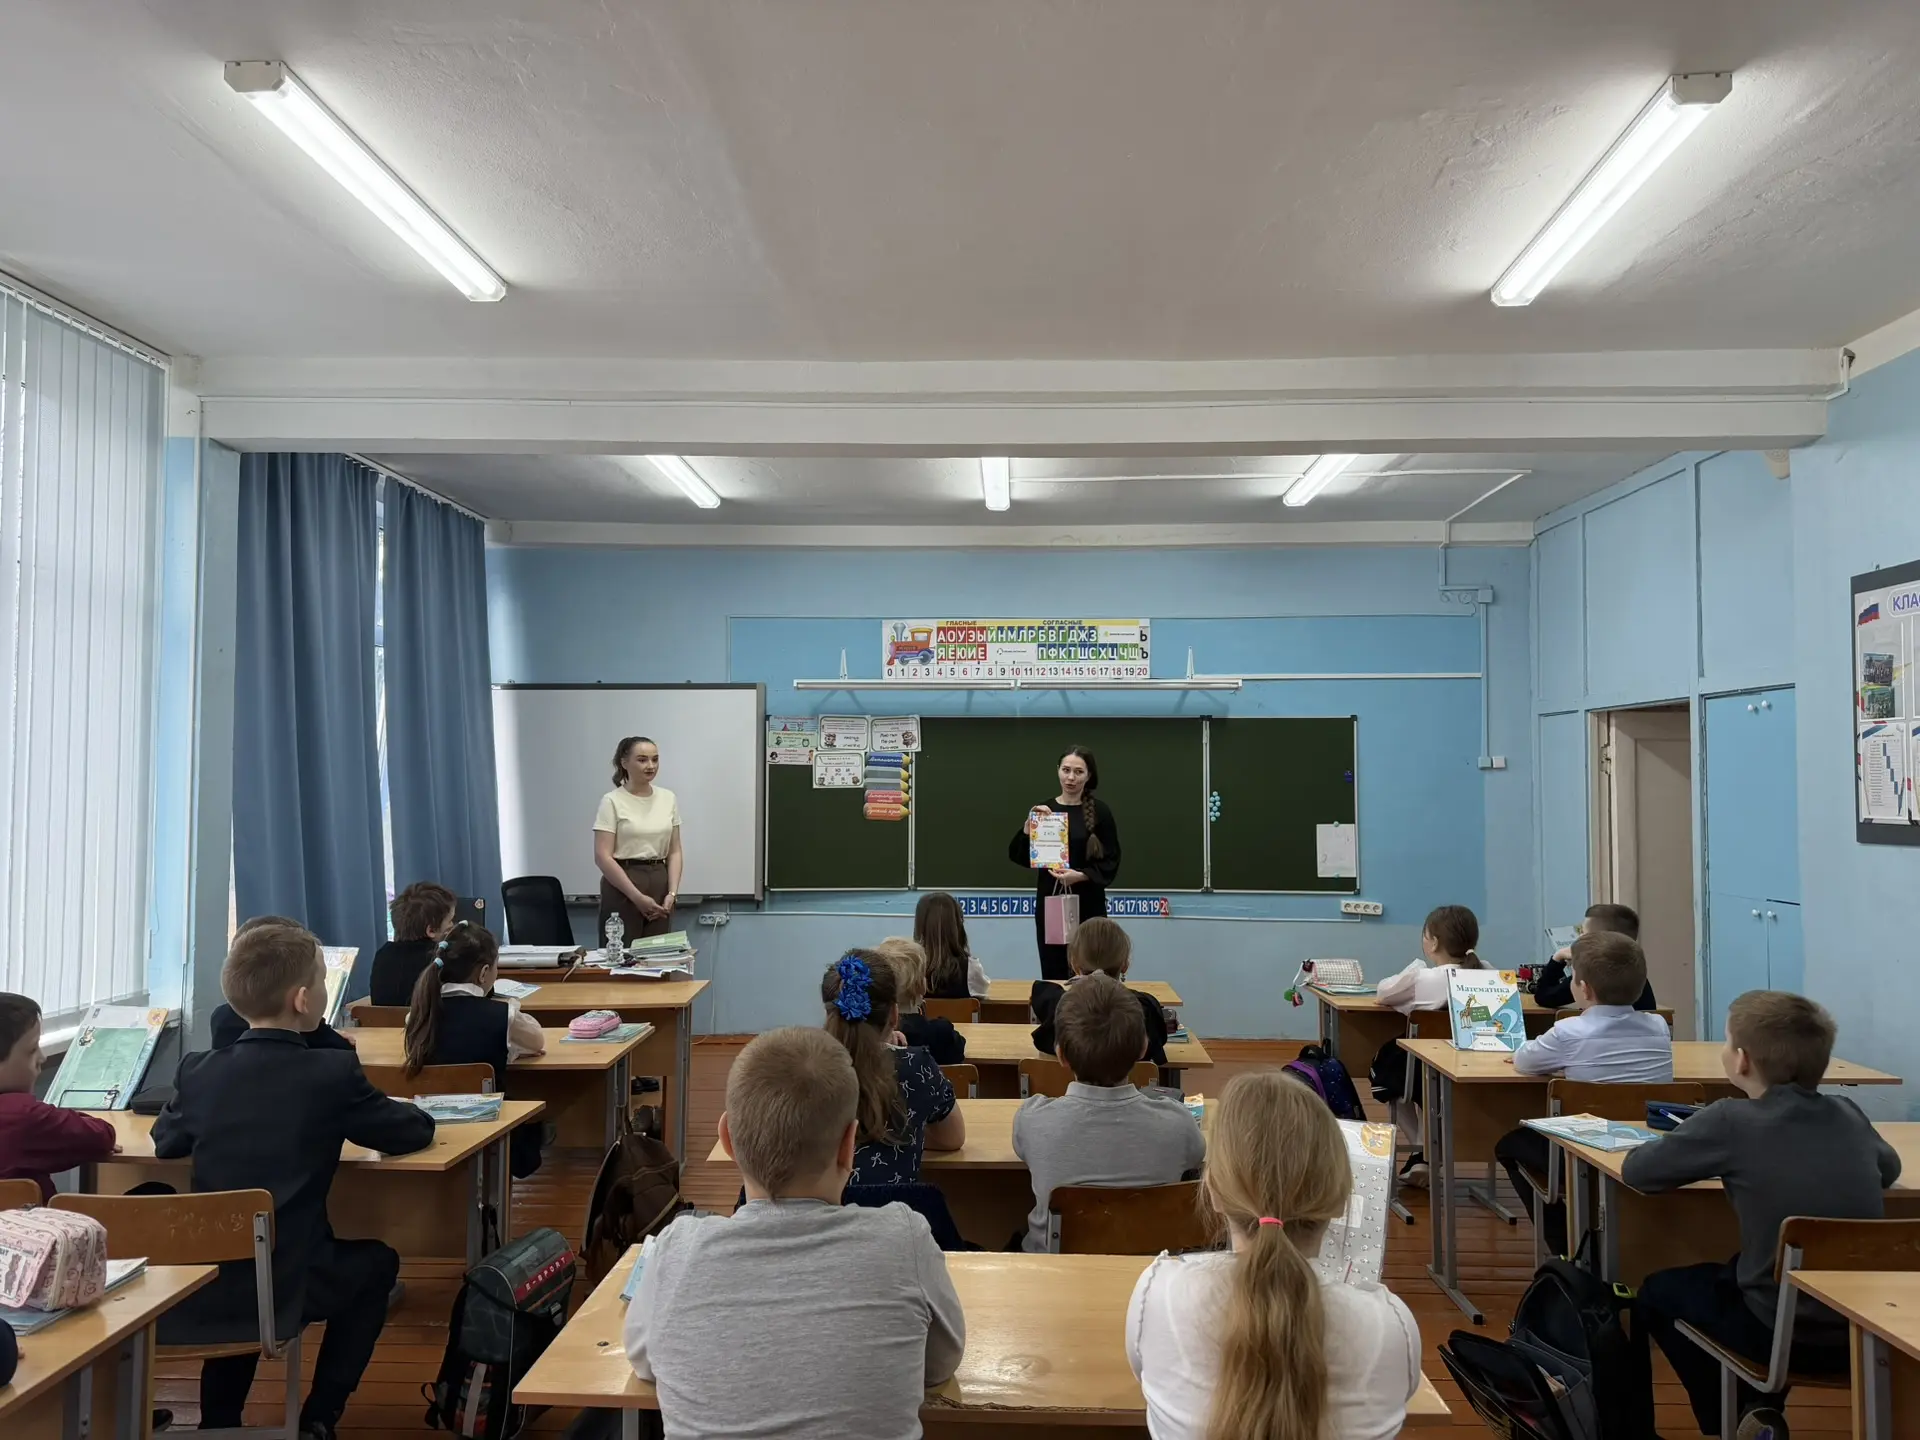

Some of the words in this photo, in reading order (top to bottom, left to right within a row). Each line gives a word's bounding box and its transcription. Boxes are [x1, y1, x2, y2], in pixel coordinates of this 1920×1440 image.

[887, 668, 893, 676] 0
[900, 668, 905, 676] 1
[912, 668, 918, 676] 2
[925, 668, 930, 676] 3
[937, 668, 943, 676] 4
[950, 668, 956, 676] 5
[962, 668, 968, 676] 6
[975, 668, 980, 676] 7
[987, 668, 993, 676] 8
[1000, 668, 1006, 676] 9
[1011, 668, 1021, 676] 10
[1024, 668, 1033, 676] 11
[1036, 668, 1046, 676] 12
[1048, 668, 1059, 676] 13
[1061, 668, 1072, 676] 14
[1074, 668, 1084, 676] 15
[1086, 668, 1097, 676] 16
[1099, 668, 1109, 676] 17
[1112, 668, 1122, 676] 18
[1124, 668, 1135, 676] 19
[1137, 668, 1148, 676] 20
[970, 900, 976, 912] 3
[981, 900, 988, 912] 4
[992, 900, 998, 912] 5
[1002, 900, 1009, 912] 6
[1012, 900, 1019, 912] 7
[1023, 900, 1030, 912] 8
[1114, 900, 1124, 912] 16
[1126, 900, 1136, 912] 17
[1138, 900, 1148, 912] 18
[1149, 900, 1160, 912] 19
[1456, 985, 1510, 994] Математика
